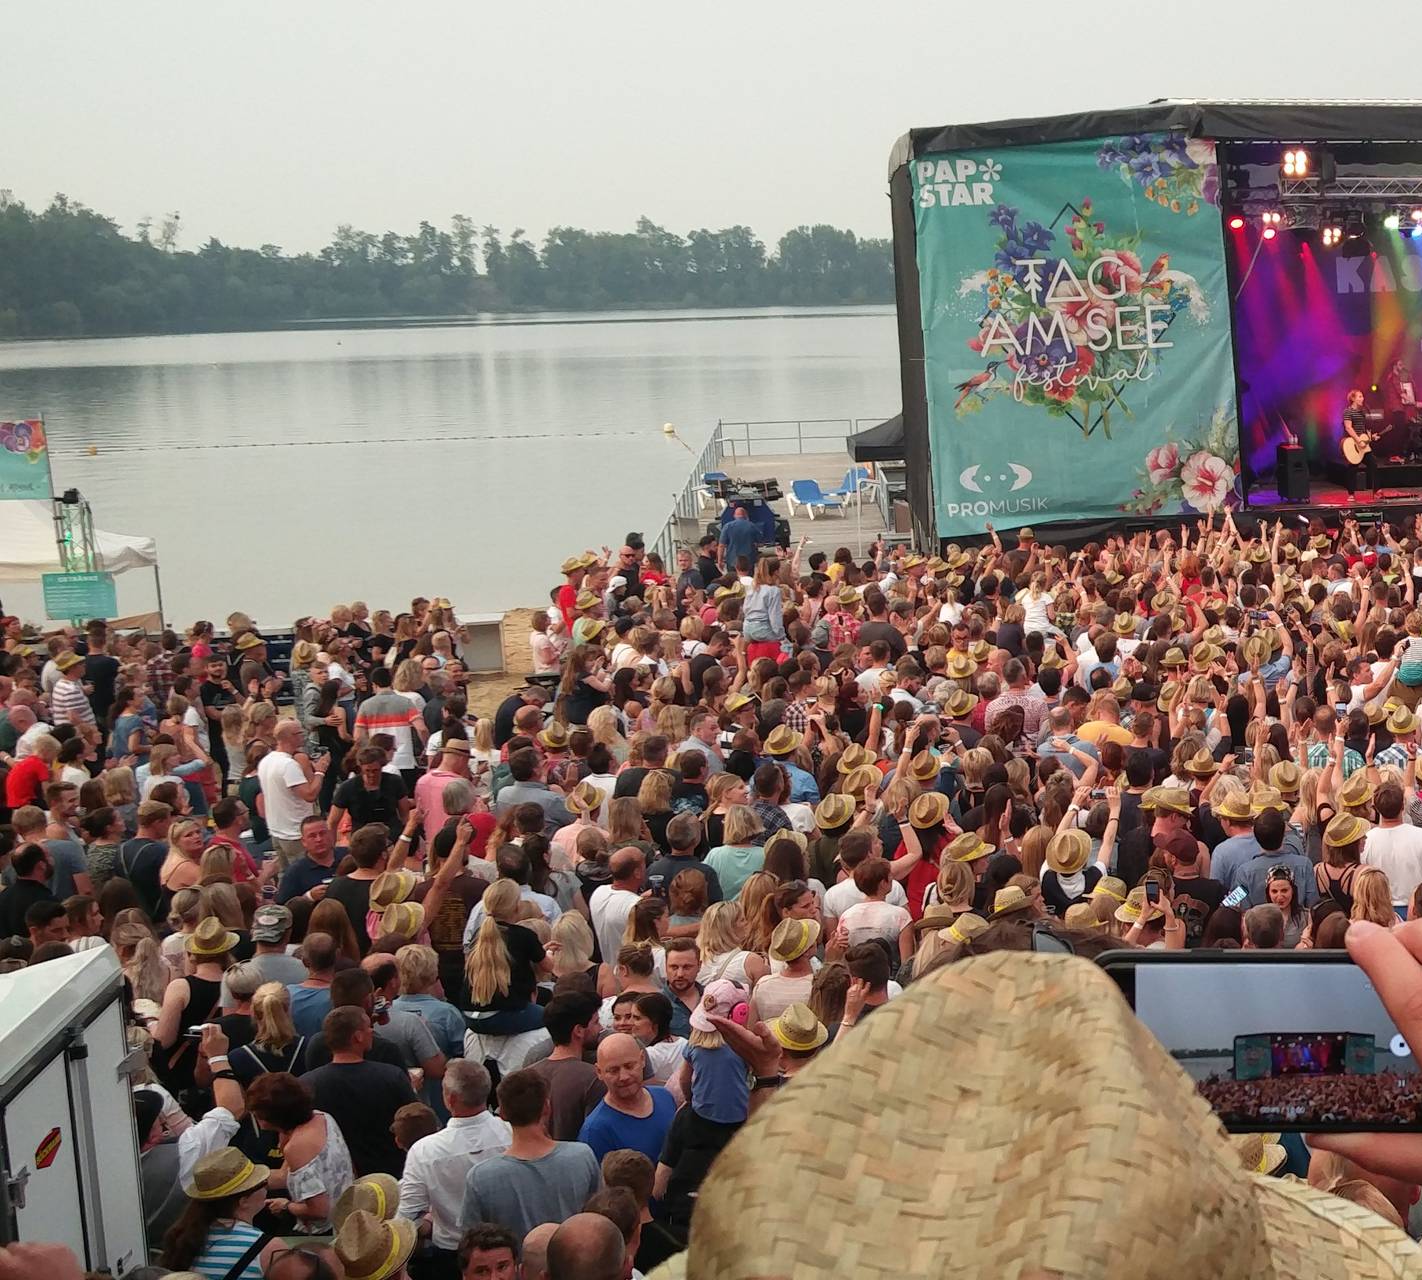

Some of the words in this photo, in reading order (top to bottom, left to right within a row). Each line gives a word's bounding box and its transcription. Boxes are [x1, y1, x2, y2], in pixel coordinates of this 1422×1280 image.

[917, 159, 977, 185] PAP
[919, 183, 995, 208] STAR
[1015, 256, 1127, 303] TAG
[980, 311, 1073, 358] AM
[1087, 304, 1174, 352] SEE
[1011, 351, 1154, 402] festival
[947, 496, 1049, 518] PROMUSIK
